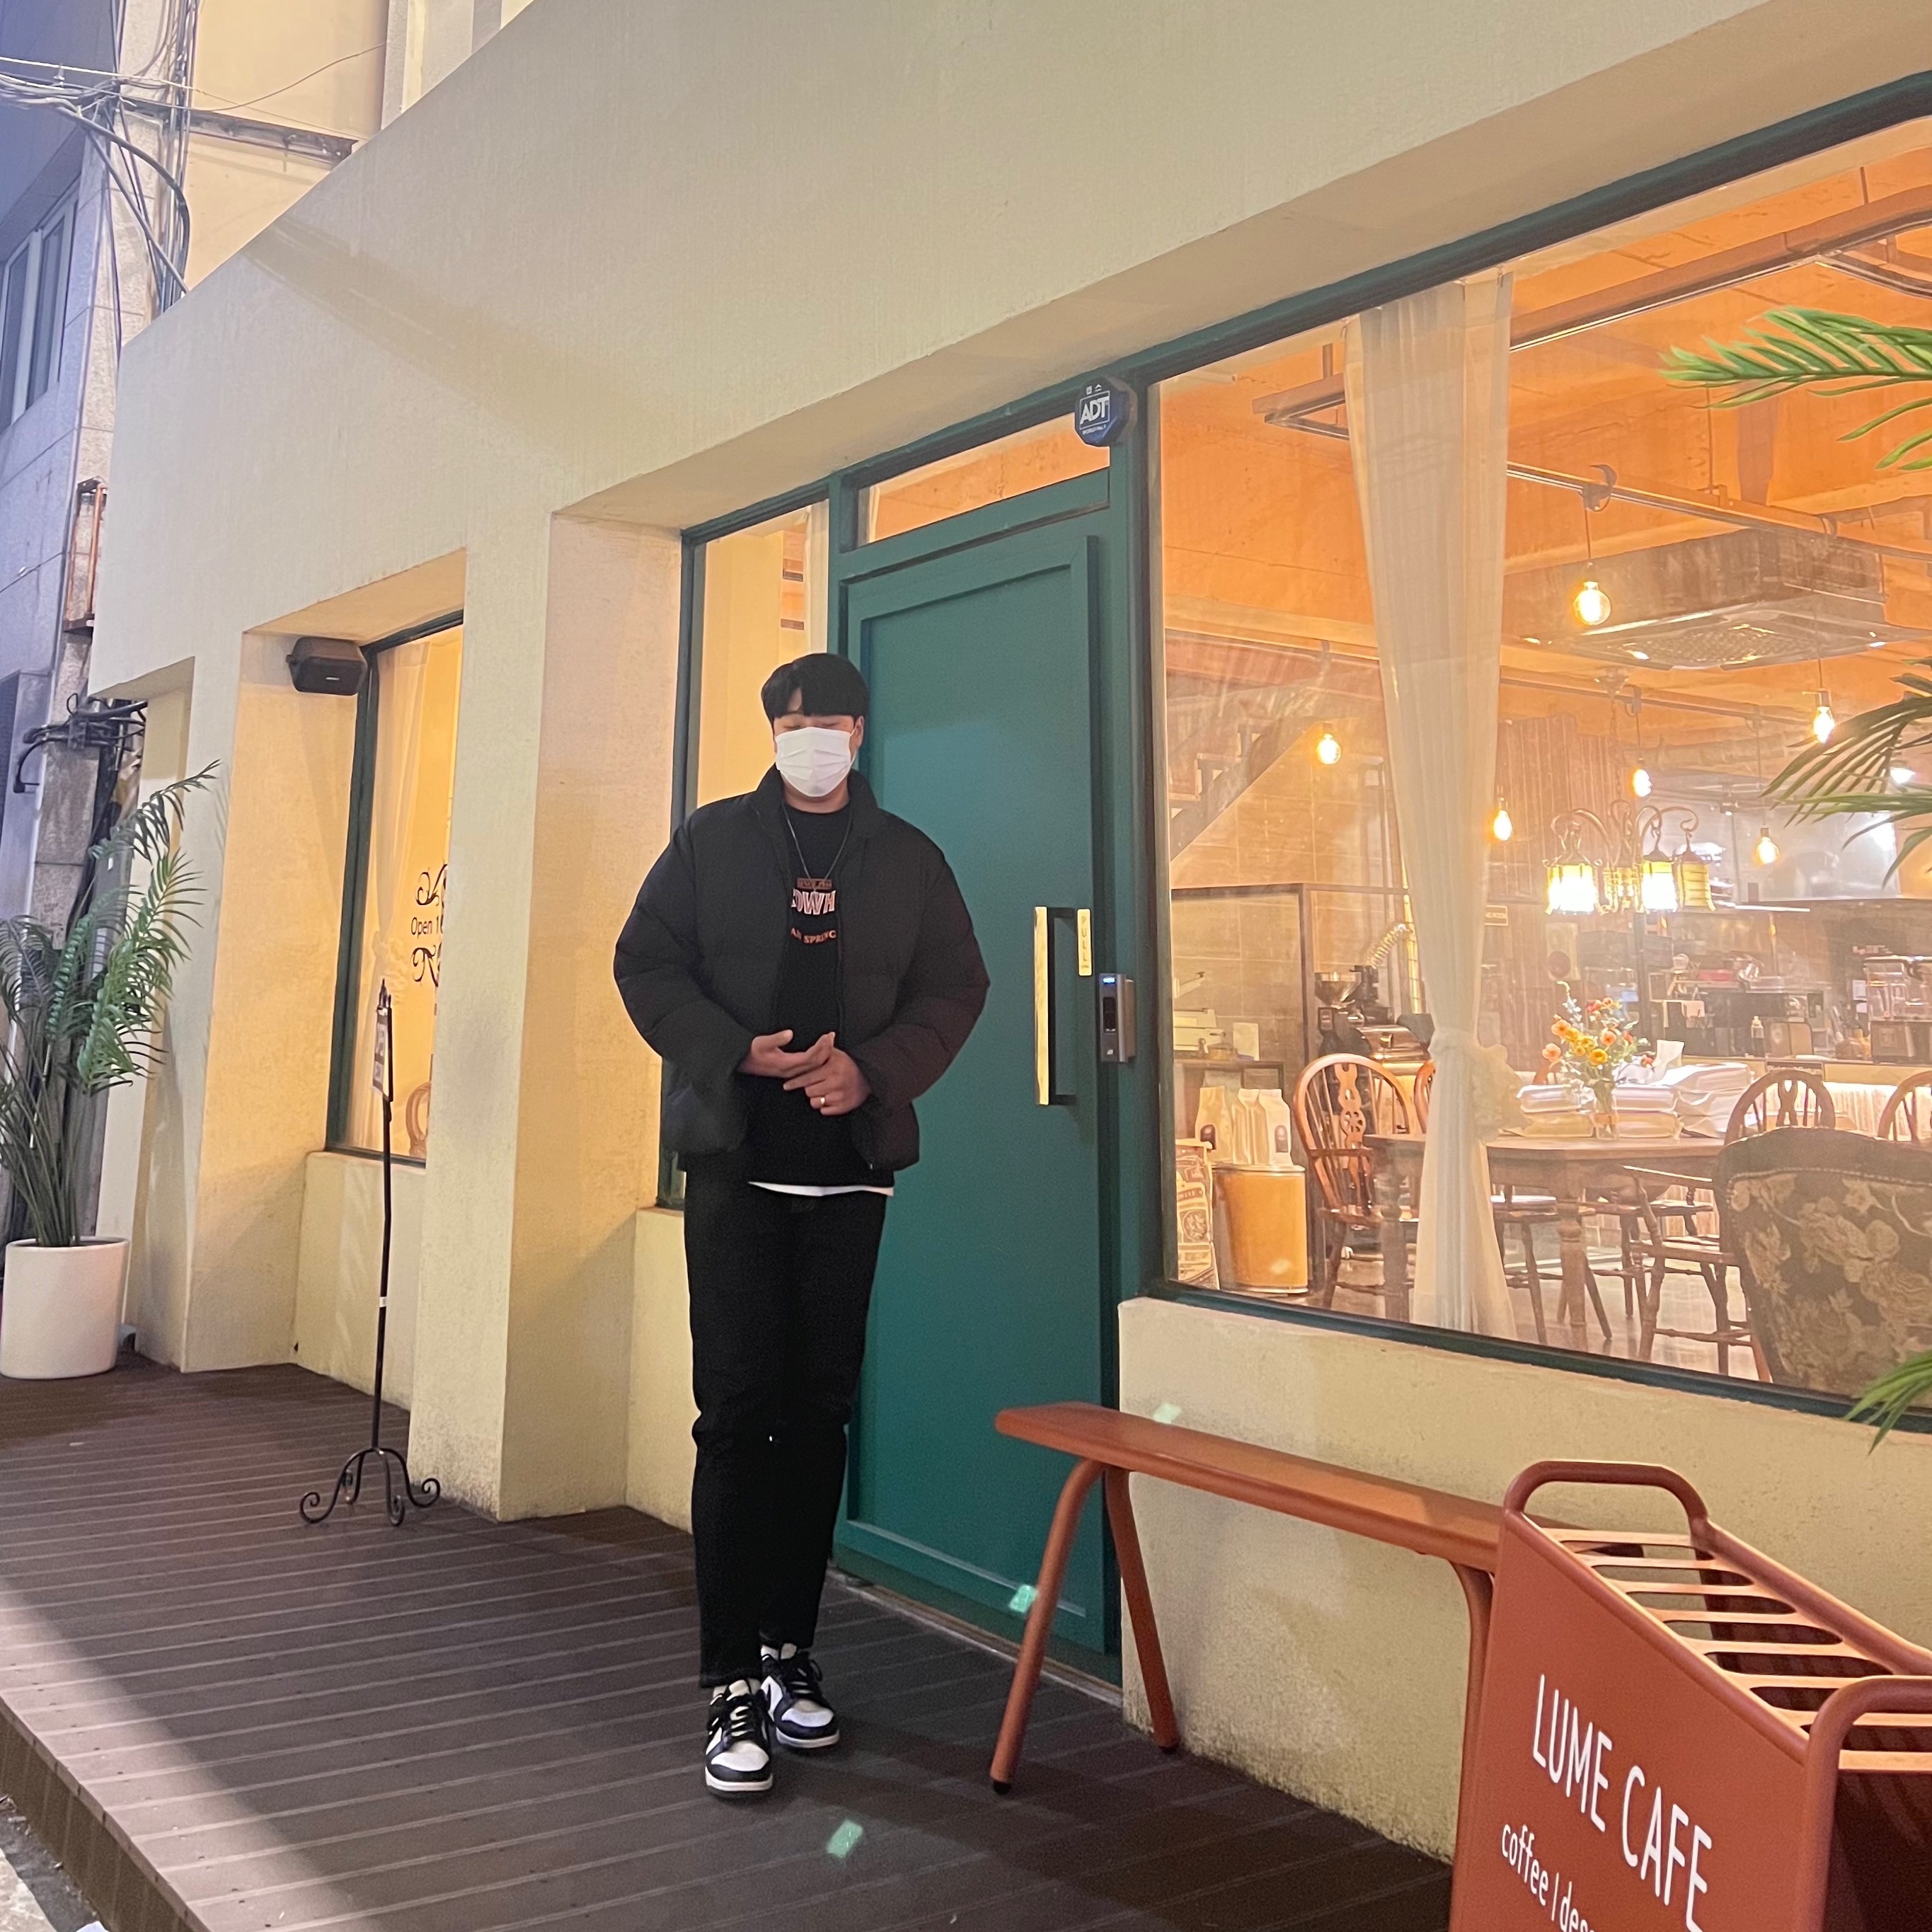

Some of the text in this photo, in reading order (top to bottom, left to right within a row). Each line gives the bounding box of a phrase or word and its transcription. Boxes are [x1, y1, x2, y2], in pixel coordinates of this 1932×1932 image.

[1080, 396, 1110, 425] ADT
[410, 916, 432, 938] Open
[1533, 1674, 1713, 1932] LUME CAFE
[1502, 1824, 1549, 1907] coffee
